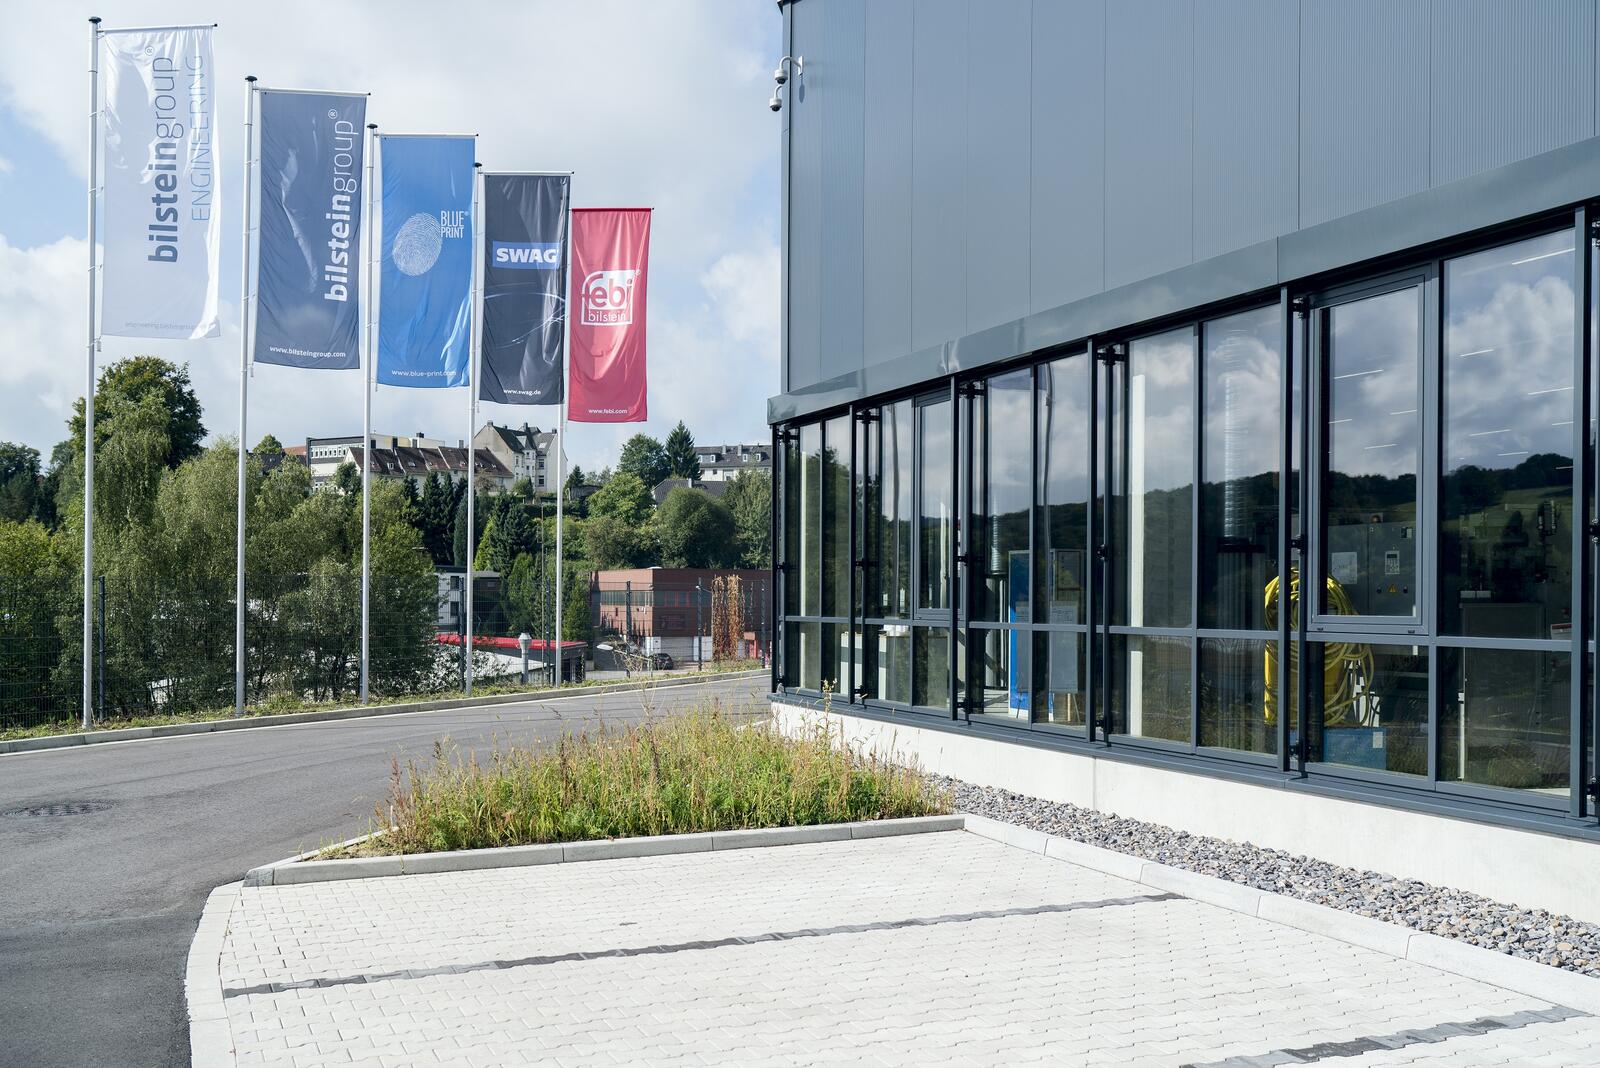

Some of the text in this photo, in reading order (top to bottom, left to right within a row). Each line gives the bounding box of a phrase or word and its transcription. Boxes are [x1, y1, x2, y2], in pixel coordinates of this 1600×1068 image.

[185, 55, 211, 221] ENGINEERING
[440, 227, 465, 239] PRINT
[496, 247, 558, 263] SWAG
[584, 273, 633, 310] febi
[588, 311, 626, 322] bilstein
[269, 346, 347, 358] www.bilsteingroup.com
[503, 388, 541, 396] www.swag.de
